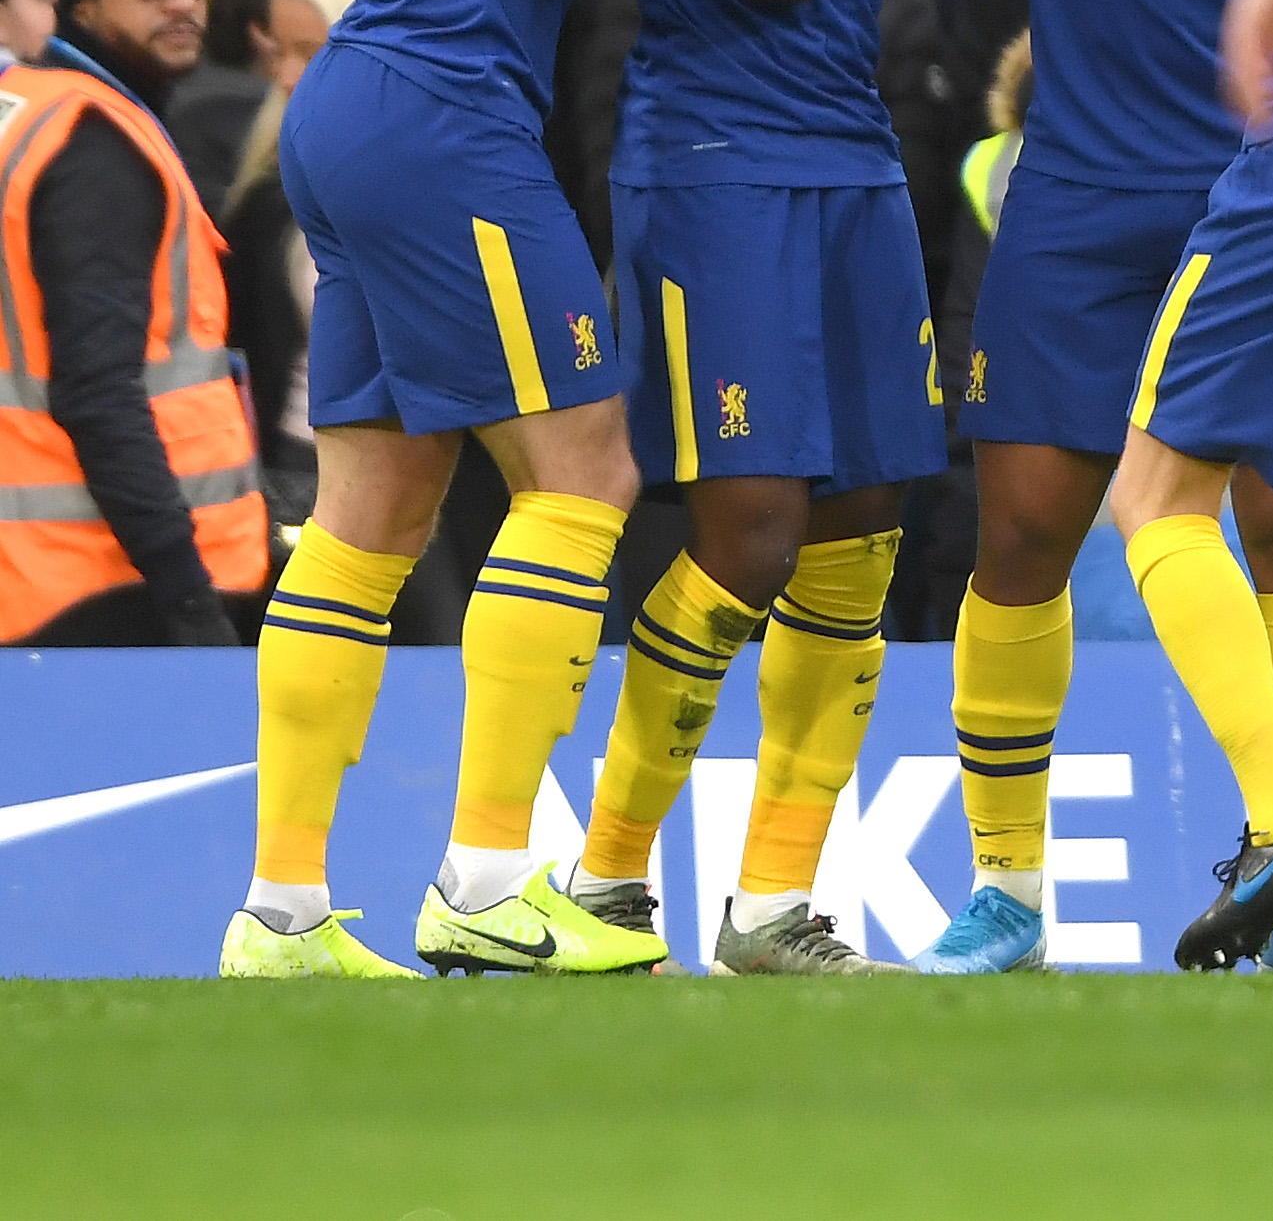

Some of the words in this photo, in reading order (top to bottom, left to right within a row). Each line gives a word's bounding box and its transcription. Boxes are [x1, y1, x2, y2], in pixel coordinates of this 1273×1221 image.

[574, 350, 602, 371] CFC
[965, 388, 986, 403] CFC
[719, 422, 751, 439] CFC
[979, 854, 1012, 867] CFC
